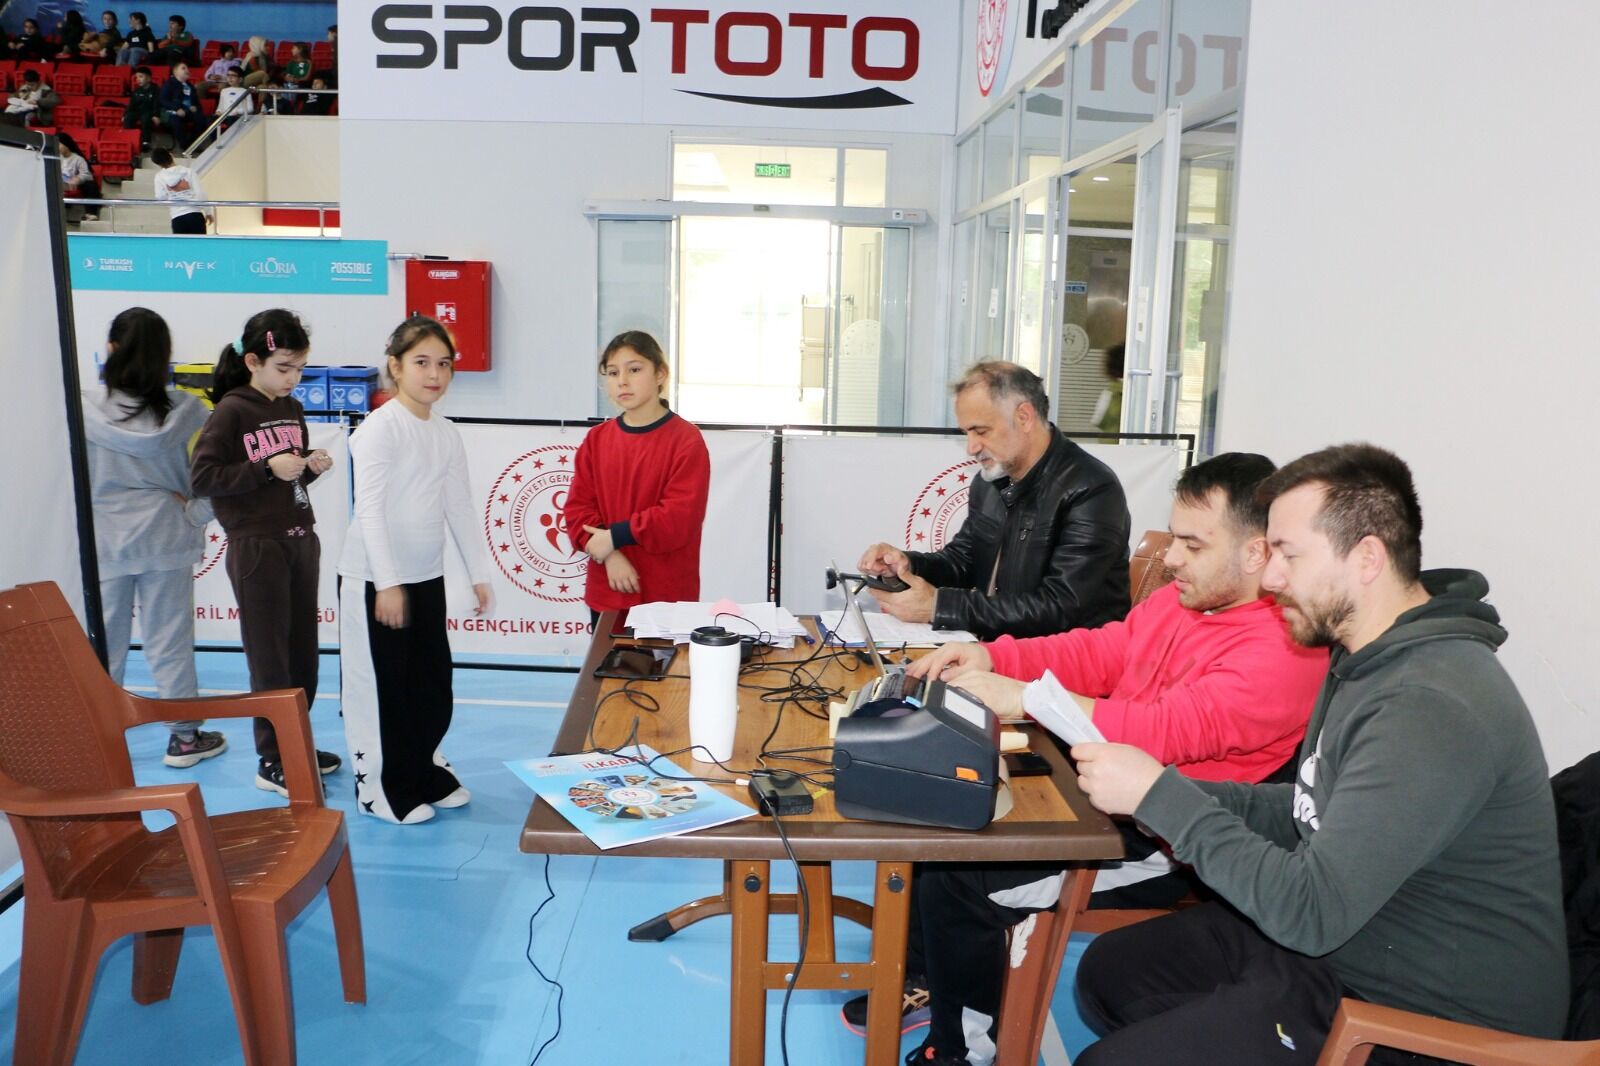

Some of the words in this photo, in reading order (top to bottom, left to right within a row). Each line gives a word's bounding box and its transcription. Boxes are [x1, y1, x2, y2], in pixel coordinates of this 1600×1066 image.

[99, 257, 133, 265] TURKISH
[99, 264, 134, 272] AIRLINES
[463, 618, 536, 636] GENÇLİK
[539, 621, 560, 634] VE
